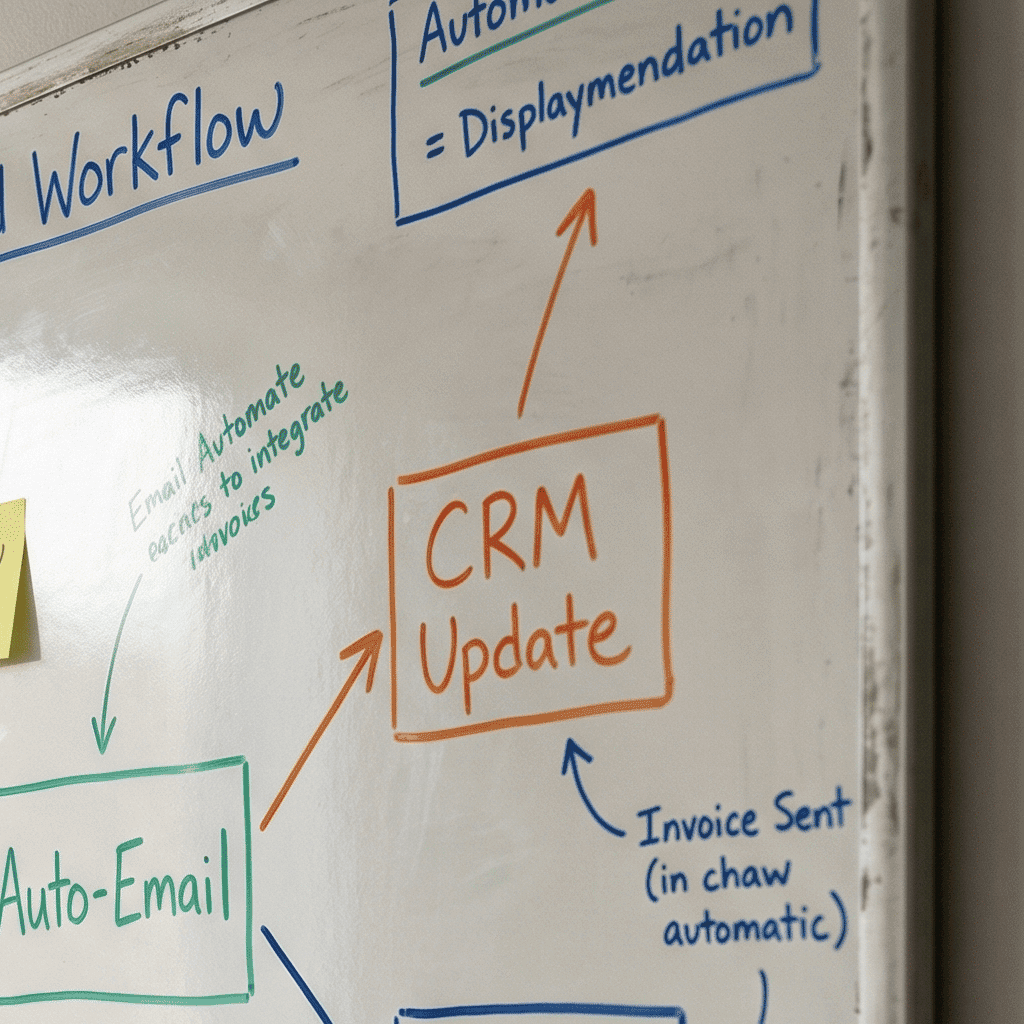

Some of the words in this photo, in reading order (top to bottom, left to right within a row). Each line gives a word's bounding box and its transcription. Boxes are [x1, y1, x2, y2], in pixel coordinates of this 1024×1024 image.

[459, 3, 794, 158] Displaymendation
[31, 81, 285, 225] Workflow
[128, 456, 187, 533] Email
[198, 362, 305, 474] Automate
[219, 470, 243, 498] to
[247, 380, 349, 474] integrate
[426, 472, 598, 589] CRM
[419, 592, 633, 716] Update
[636, 803, 759, 848] Invoice
[774, 785, 853, 832] Sent
[646, 857, 688, 903] (in
[703, 855, 792, 893] chaw
[663, 890, 848, 951] automatic)
